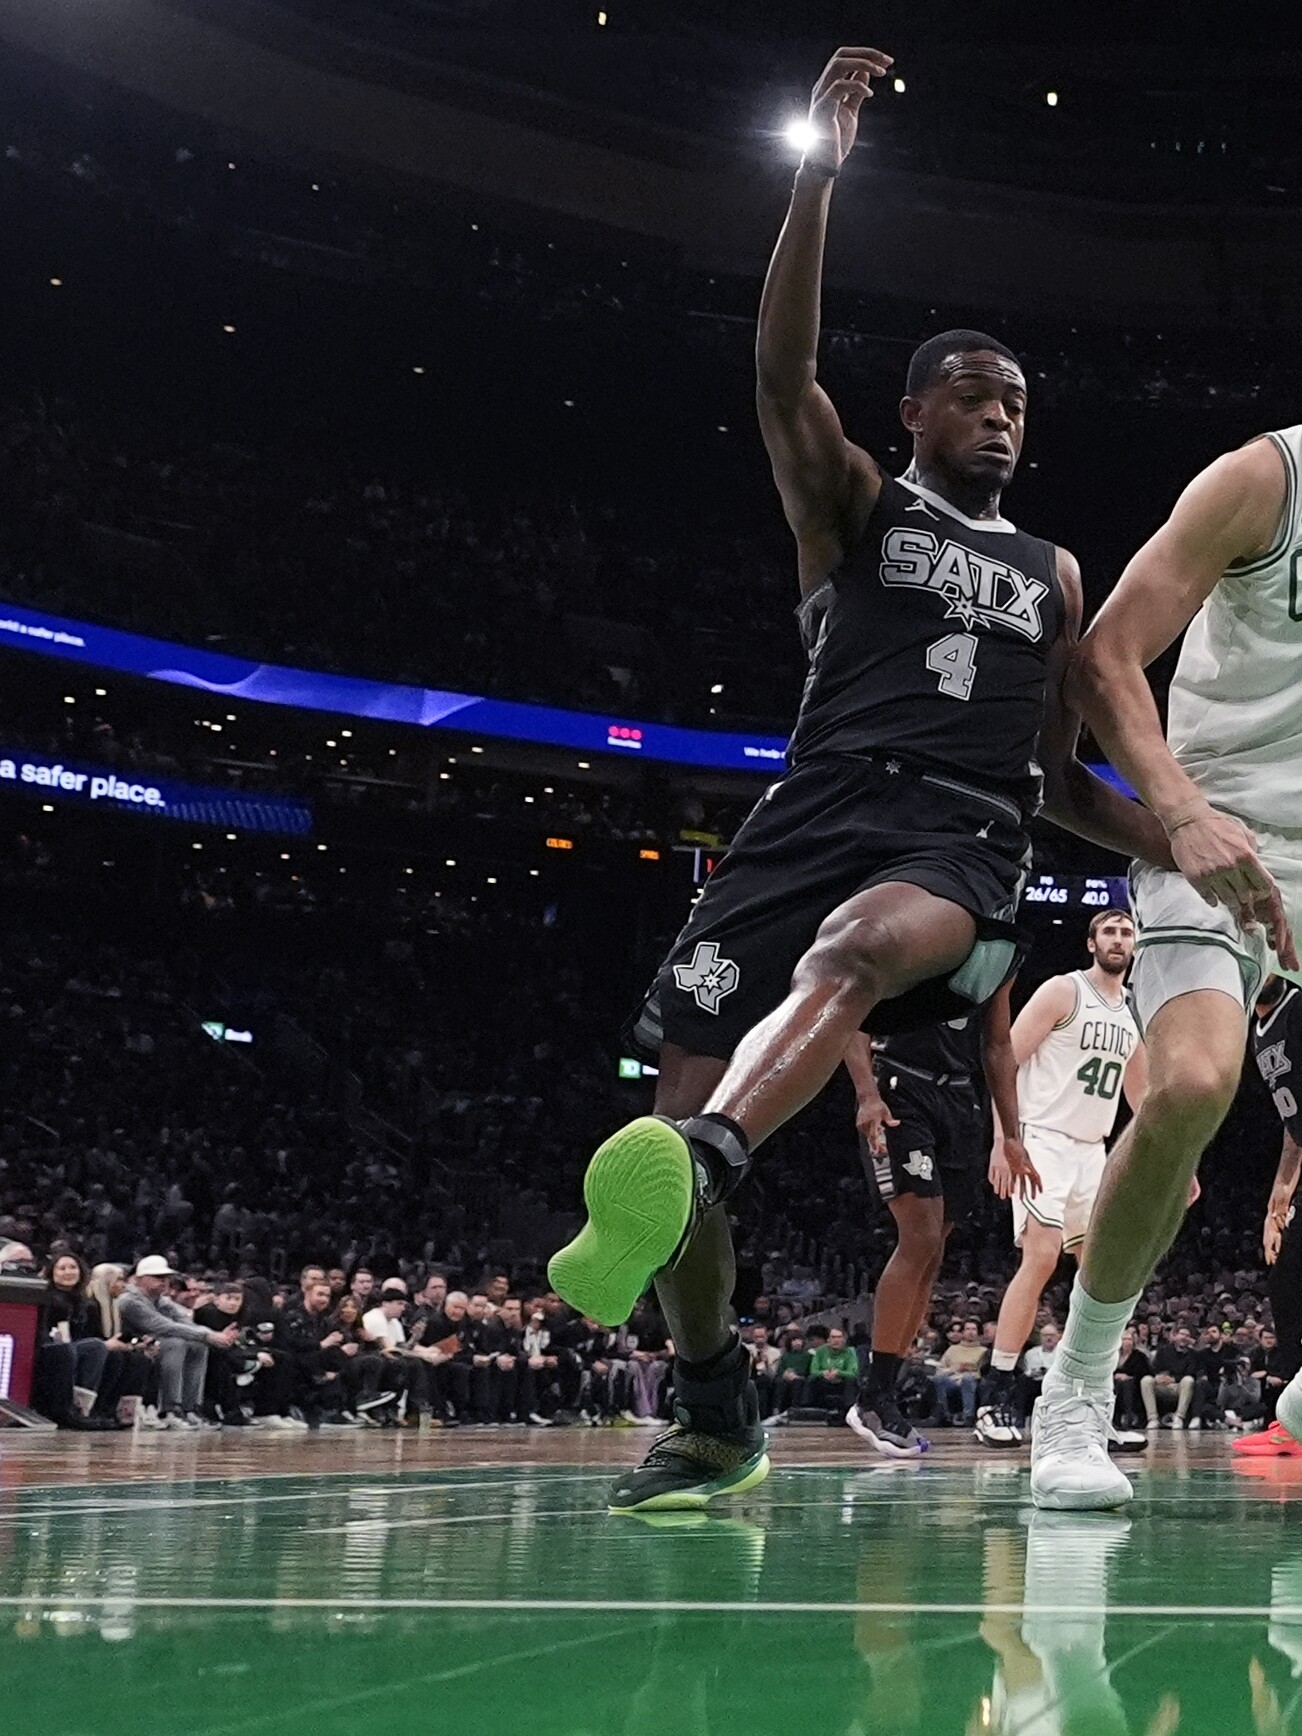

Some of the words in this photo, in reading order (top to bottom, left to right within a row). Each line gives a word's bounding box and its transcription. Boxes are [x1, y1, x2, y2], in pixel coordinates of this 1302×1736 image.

[879, 527, 1050, 643] SATX
[926, 632, 979, 701] 4
[0, 759, 17, 779] a
[21, 764, 88, 791] safer
[90, 775, 166, 807] place.
[1025, 886, 1068, 903] 26/65
[1081, 891, 1110, 905] 40.0
[1077, 1056, 1122, 1100] 40
